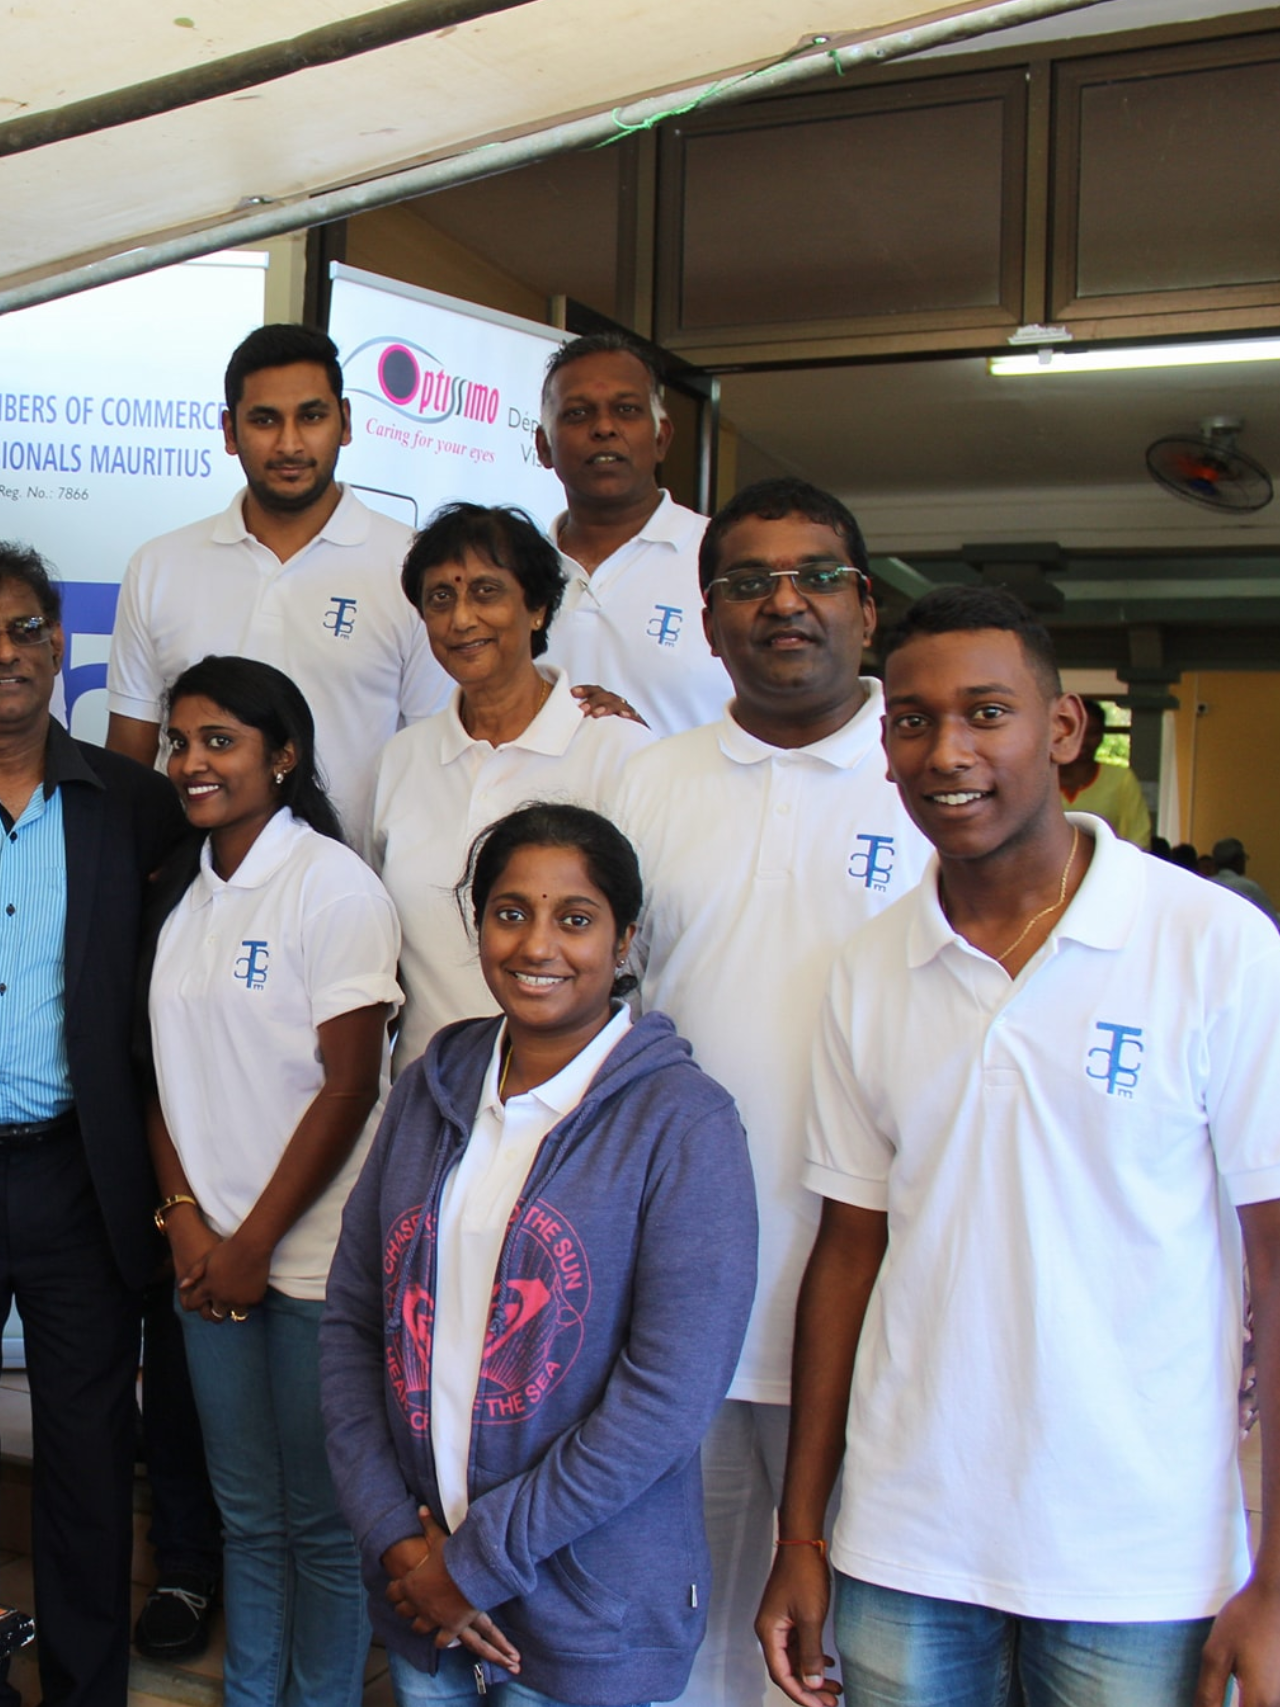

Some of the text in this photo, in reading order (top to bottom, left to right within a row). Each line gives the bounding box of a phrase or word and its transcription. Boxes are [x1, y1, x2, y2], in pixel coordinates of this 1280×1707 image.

[65, 396, 93, 425] OF
[90, 444, 211, 477] MAURITIUS
[366, 417, 496, 464] Caring for your eyes
[58, 487, 89, 500] 7866
[524, 1206, 562, 1243] THE
[553, 1238, 583, 1290] SUN
[485, 1392, 526, 1417] THE
[525, 1362, 560, 1404] SEA
